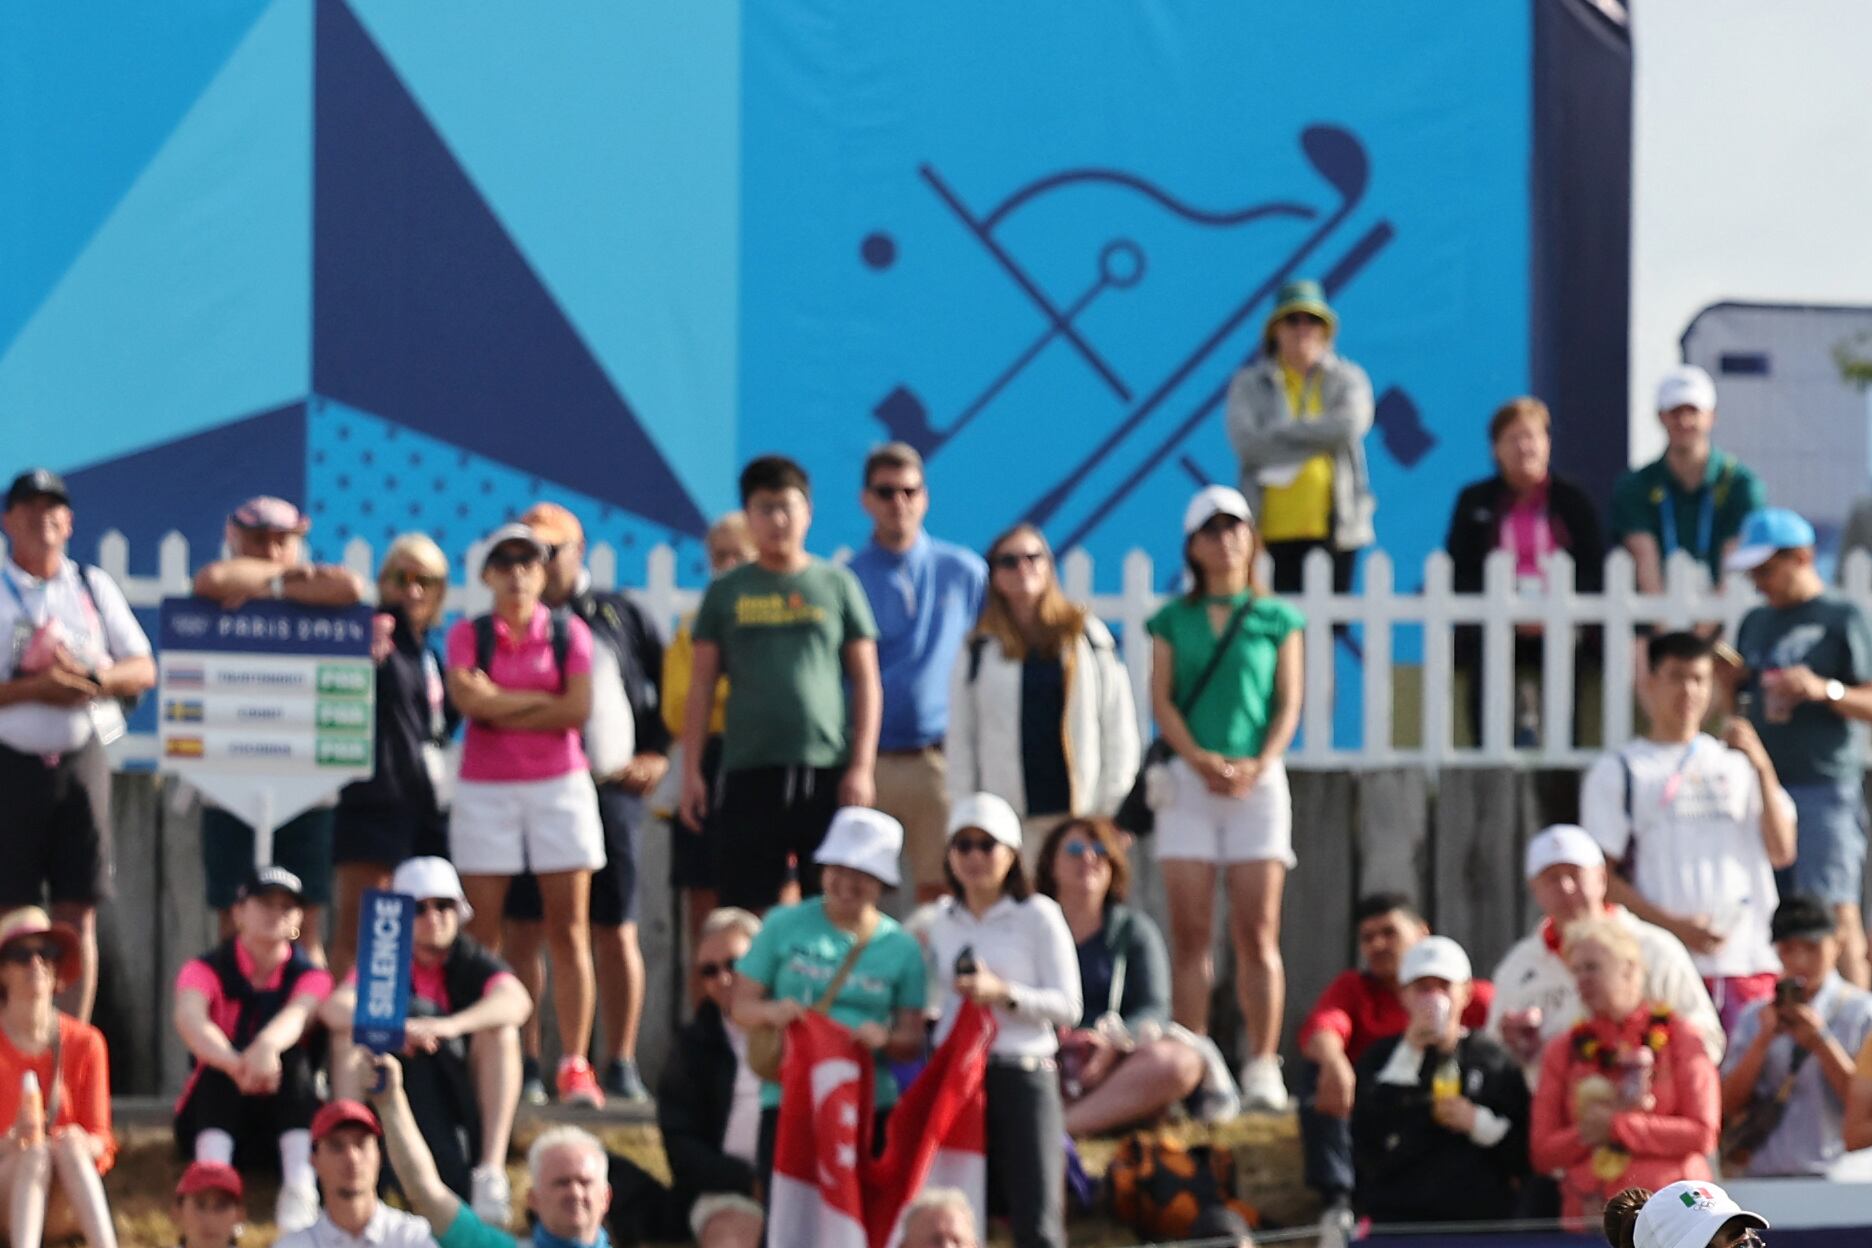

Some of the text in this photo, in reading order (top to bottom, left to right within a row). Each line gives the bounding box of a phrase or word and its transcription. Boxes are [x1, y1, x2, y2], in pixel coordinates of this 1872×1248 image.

[218, 615, 365, 642] PARIS 2024
[367, 896, 404, 1020] SILENCE
